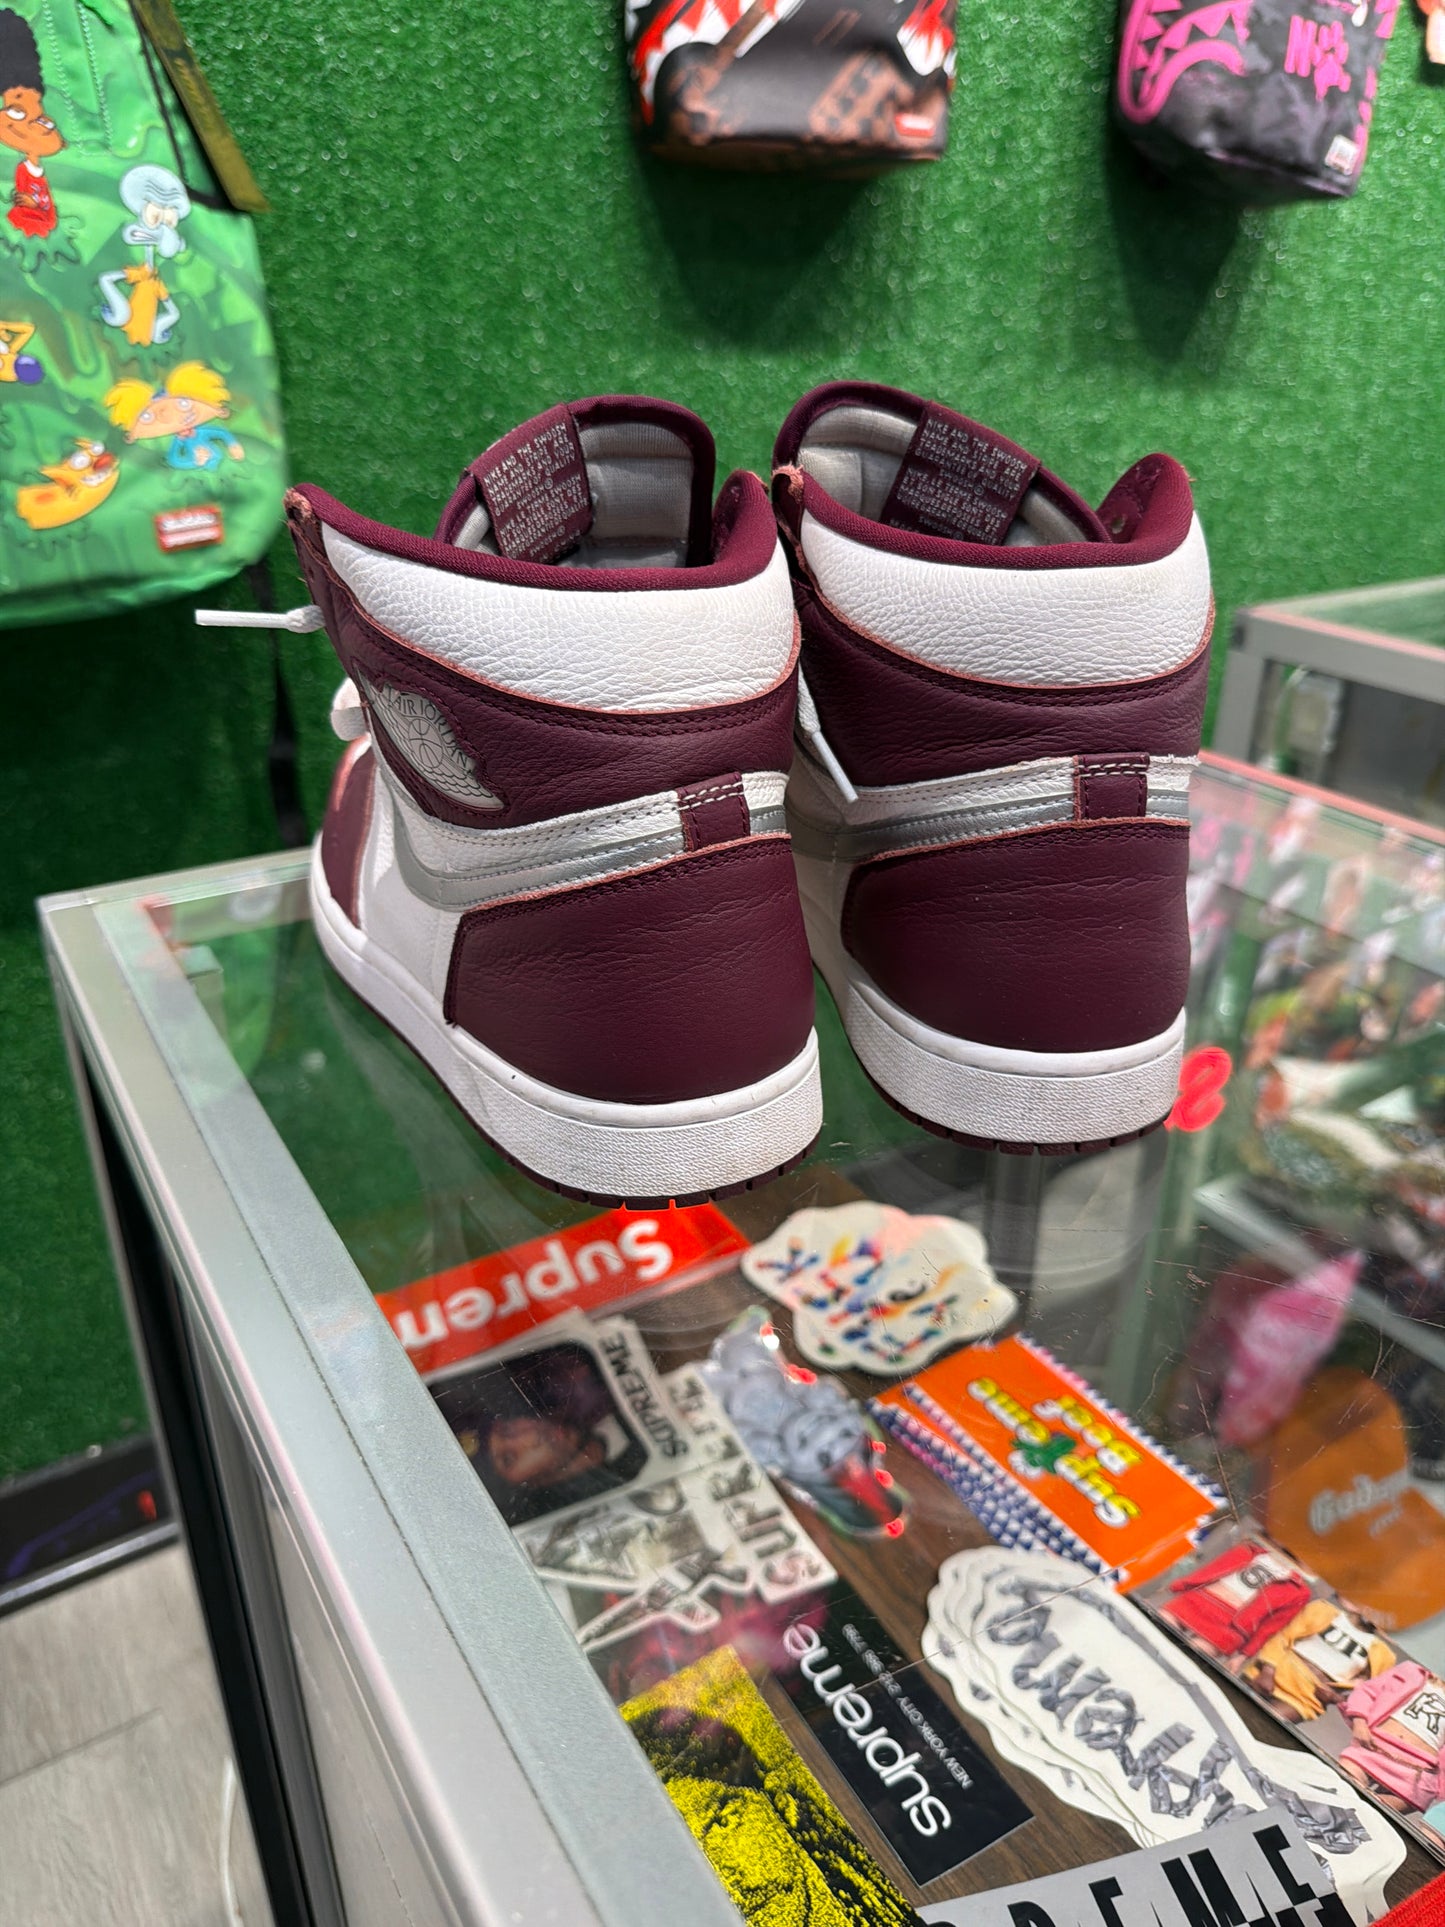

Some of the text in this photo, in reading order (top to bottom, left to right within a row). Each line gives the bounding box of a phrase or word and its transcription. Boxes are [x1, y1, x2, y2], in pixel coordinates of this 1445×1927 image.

[483, 422, 566, 486] NIKE AND THE SWOOSH
[487, 433, 568, 498] NAME AND STRIPE ARE
[921, 428, 1021, 481] NAME AND STRIPE ARE
[925, 417, 1027, 473] NIKE AND THE SWOOSH
[491, 441, 574, 506] TRADEMARKS AND YOUR
[389, 697, 417, 715] AIR
[600, 1332, 689, 1457] SUPREME
[1317, 1625, 1368, 1659] UP
[783, 1623, 952, 1836] supreme
[898, 1696, 924, 1727] CITY
[919, 1721, 949, 1760] YORK
[943, 1757, 974, 1790] NEW
